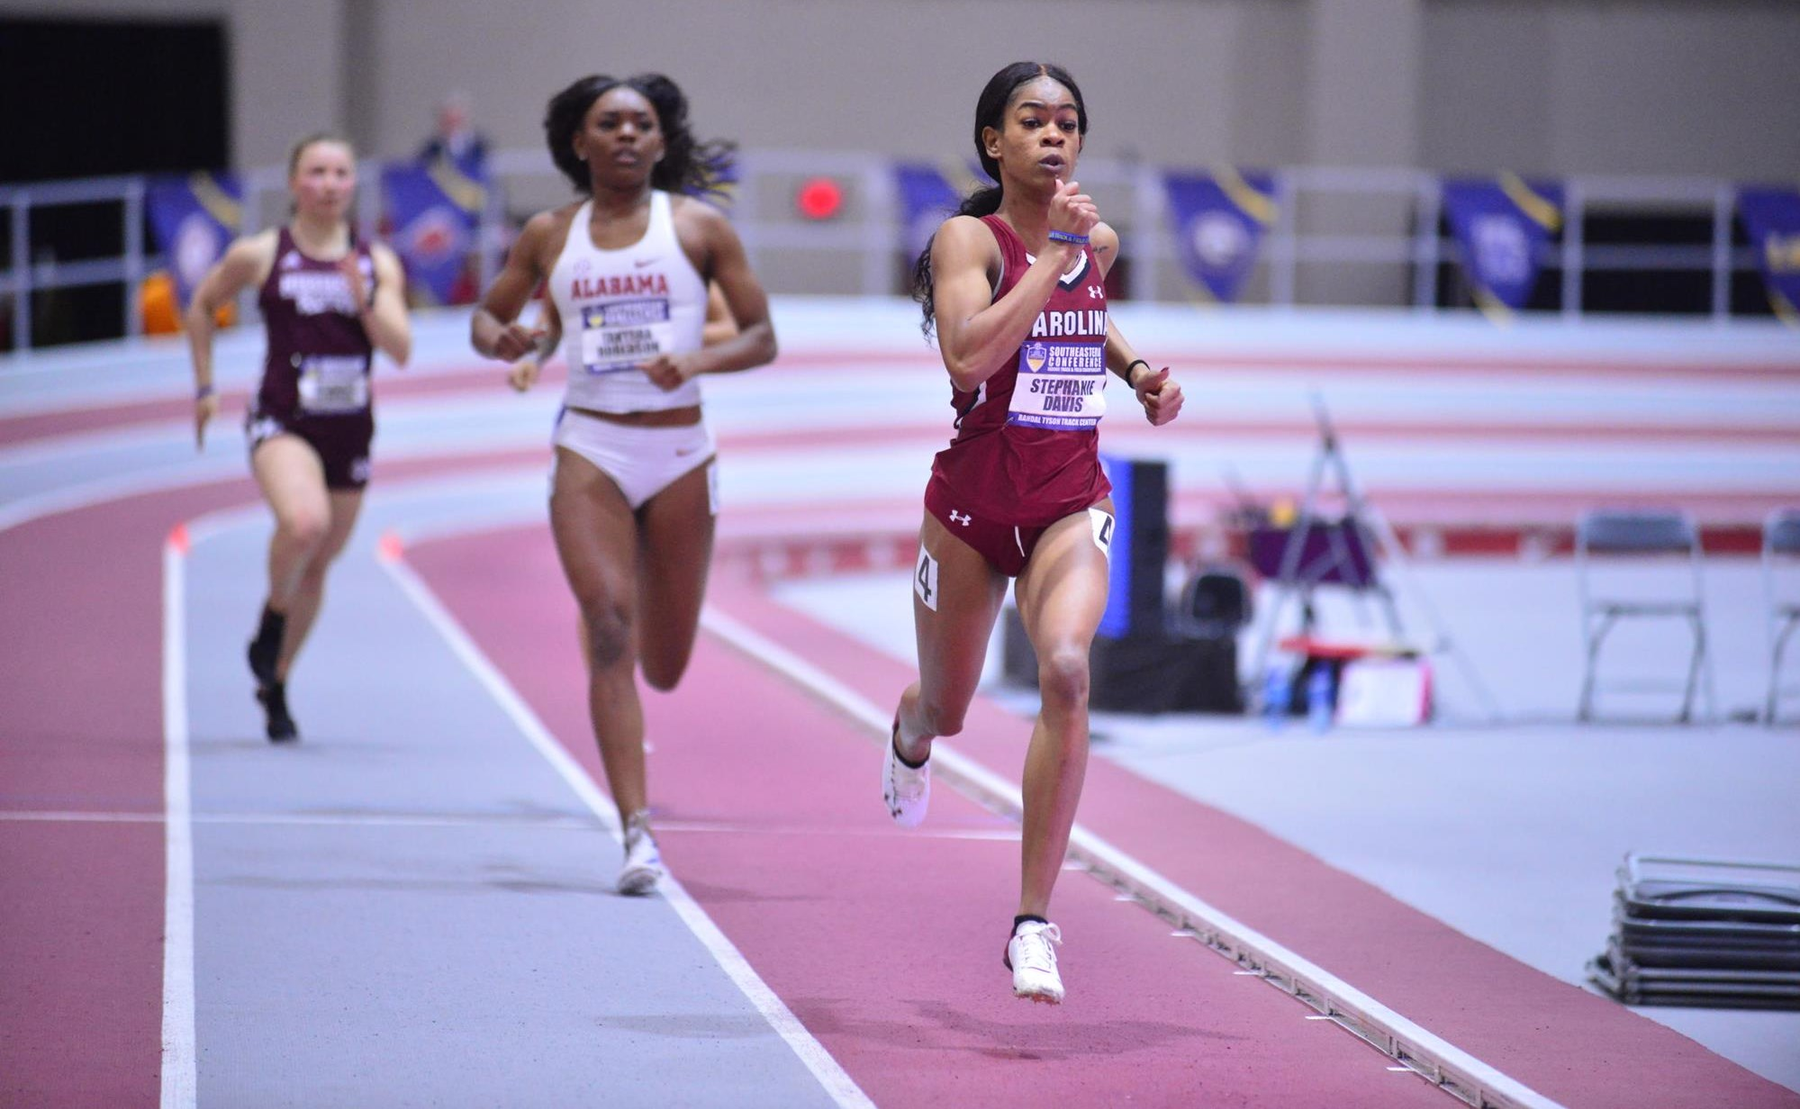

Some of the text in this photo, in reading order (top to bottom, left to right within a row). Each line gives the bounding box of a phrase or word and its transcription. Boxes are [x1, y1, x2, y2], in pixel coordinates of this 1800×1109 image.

[571, 274, 668, 300] ALABAMA
[1032, 310, 1108, 337] AROLIN
[1049, 346, 1102, 357] SOUTHEASTERN
[1048, 357, 1102, 367] CONFERENCE
[1030, 378, 1096, 395] STEPHANIE
[1042, 395, 1084, 413] DAVIS
[1018, 414, 1040, 424] RANDAL
[1042, 416, 1061, 425] TYSON
[1061, 418, 1079, 426] TRACK
[918, 554, 932, 603] 4
